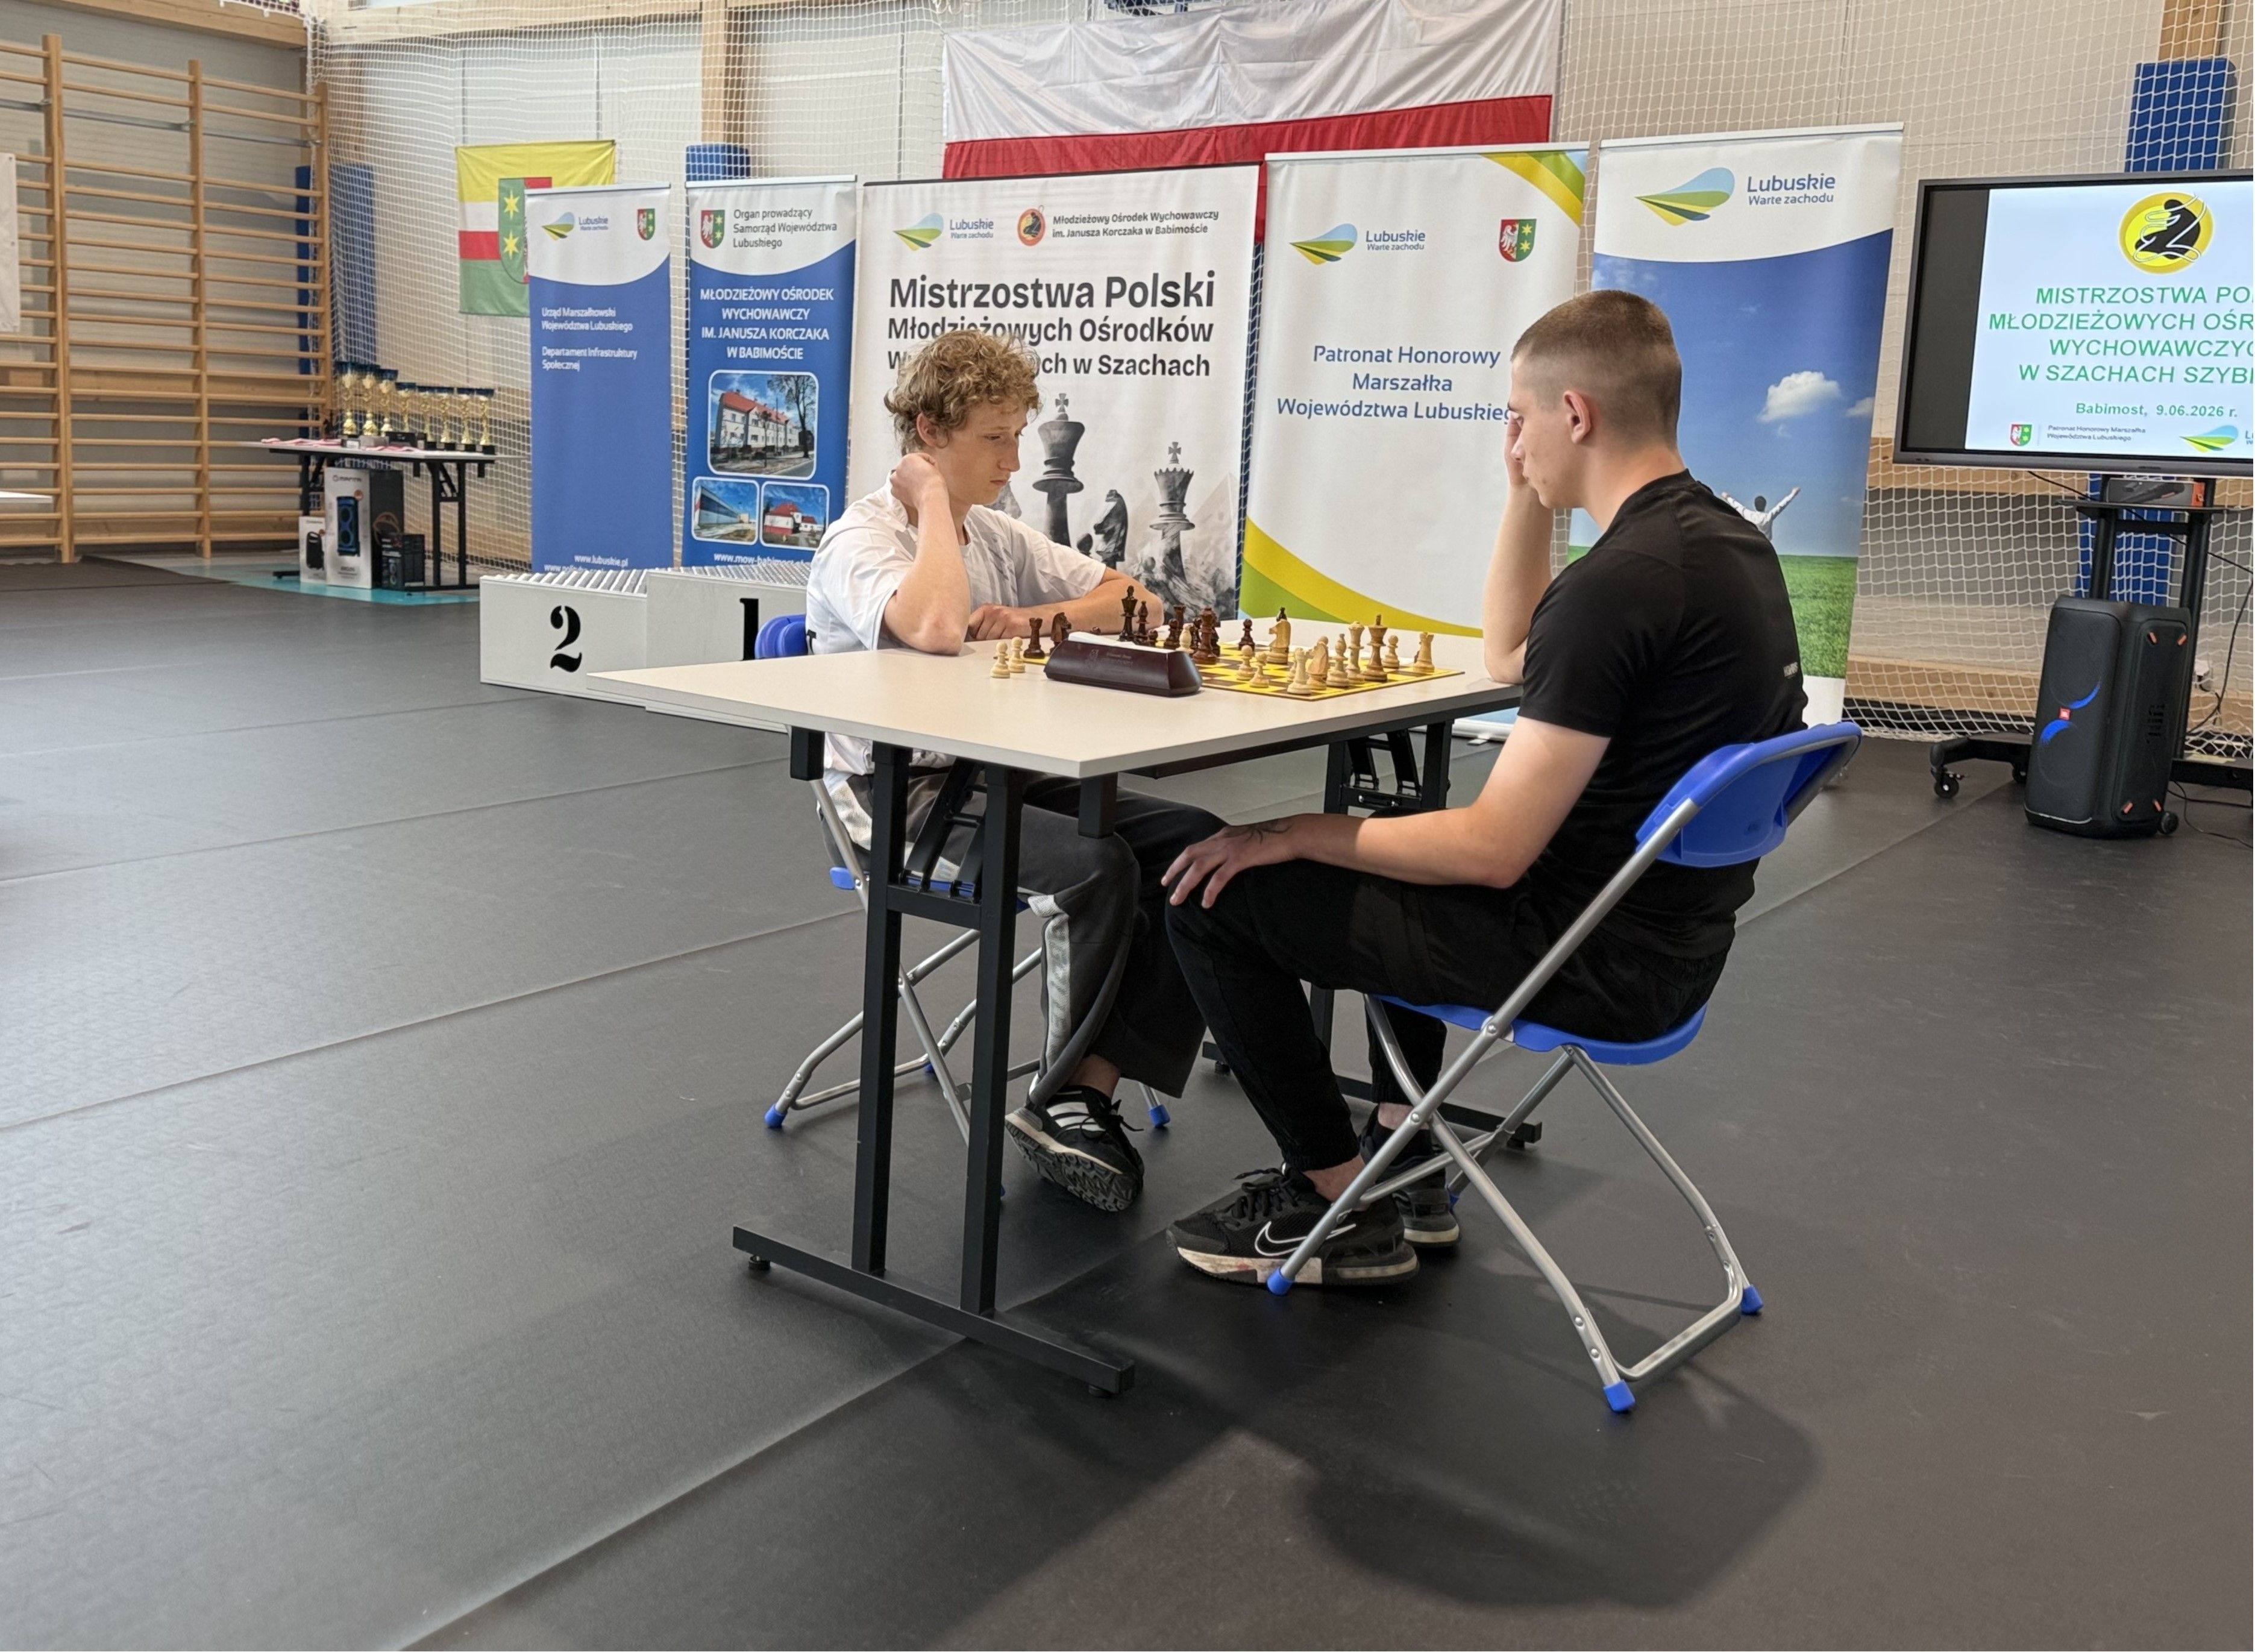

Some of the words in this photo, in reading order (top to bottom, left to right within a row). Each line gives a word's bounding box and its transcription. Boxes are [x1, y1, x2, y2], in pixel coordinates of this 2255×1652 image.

[1747, 172, 1836, 192] Lubuskie
[1749, 195, 1782, 206] Warte
[1784, 192, 1834, 204] zachodu
[733, 209, 760, 221] Organ
[762, 208, 813, 221] prowadzący
[1053, 214, 1109, 225] Młodzieżowy
[1111, 212, 1148, 222] Ośrodek
[1150, 211, 1219, 222] Wychowawczy
[733, 222, 776, 235] Samorząd
[777, 222, 837, 234] Województwa
[950, 218, 994, 230] Lubuskie
[1052, 229, 1065, 237] im.
[1067, 228, 1100, 237] Janusza
[1103, 227, 1143, 236] Korczaka
[1155, 224, 1208, 234] Babimoście
[1366, 229, 1426, 242] Lubuskie
[733, 237, 783, 250] Lubuskiego
[700, 286, 780, 301] MŁODZIEŻOWY
[781, 286, 834, 301] OŚRODEK
[890, 274, 1094, 309] Mistrzostwa
[1105, 270, 1215, 308] Polski
[2036, 286, 2207, 304] MISTRZOSTWA
[2216, 286, 2253, 304] PO
[722, 308, 811, 320] WYCHOWAWCZY
[1989, 309, 2195, 330] MŁODZIEŻOWYCH
[701, 327, 716, 339] IM.
[718, 327, 767, 339] JANUSZA
[769, 328, 829, 340] KORCZAKA
[1080, 315, 1214, 342] Ośrodków
[727, 347, 737, 358] W
[739, 345, 803, 359] BABIMOŚCIE
[1314, 345, 1393, 363] Patronat
[1397, 346, 1501, 369] Honorowy
[1073, 358, 1093, 374] w
[1098, 354, 1209, 377] Szachach
[2019, 364, 2040, 381] W
[2045, 365, 2175, 383] SZACHACH
[2183, 366, 2253, 385] SZYB
[1352, 373, 1452, 392] Marszałka
[1277, 398, 1408, 419] Województwa
[2076, 403, 2148, 416] Babimost,
[2156, 405, 2224, 417] 9.06.2026
[2229, 408, 2238, 417] r.
[550, 606, 582, 673] 2
